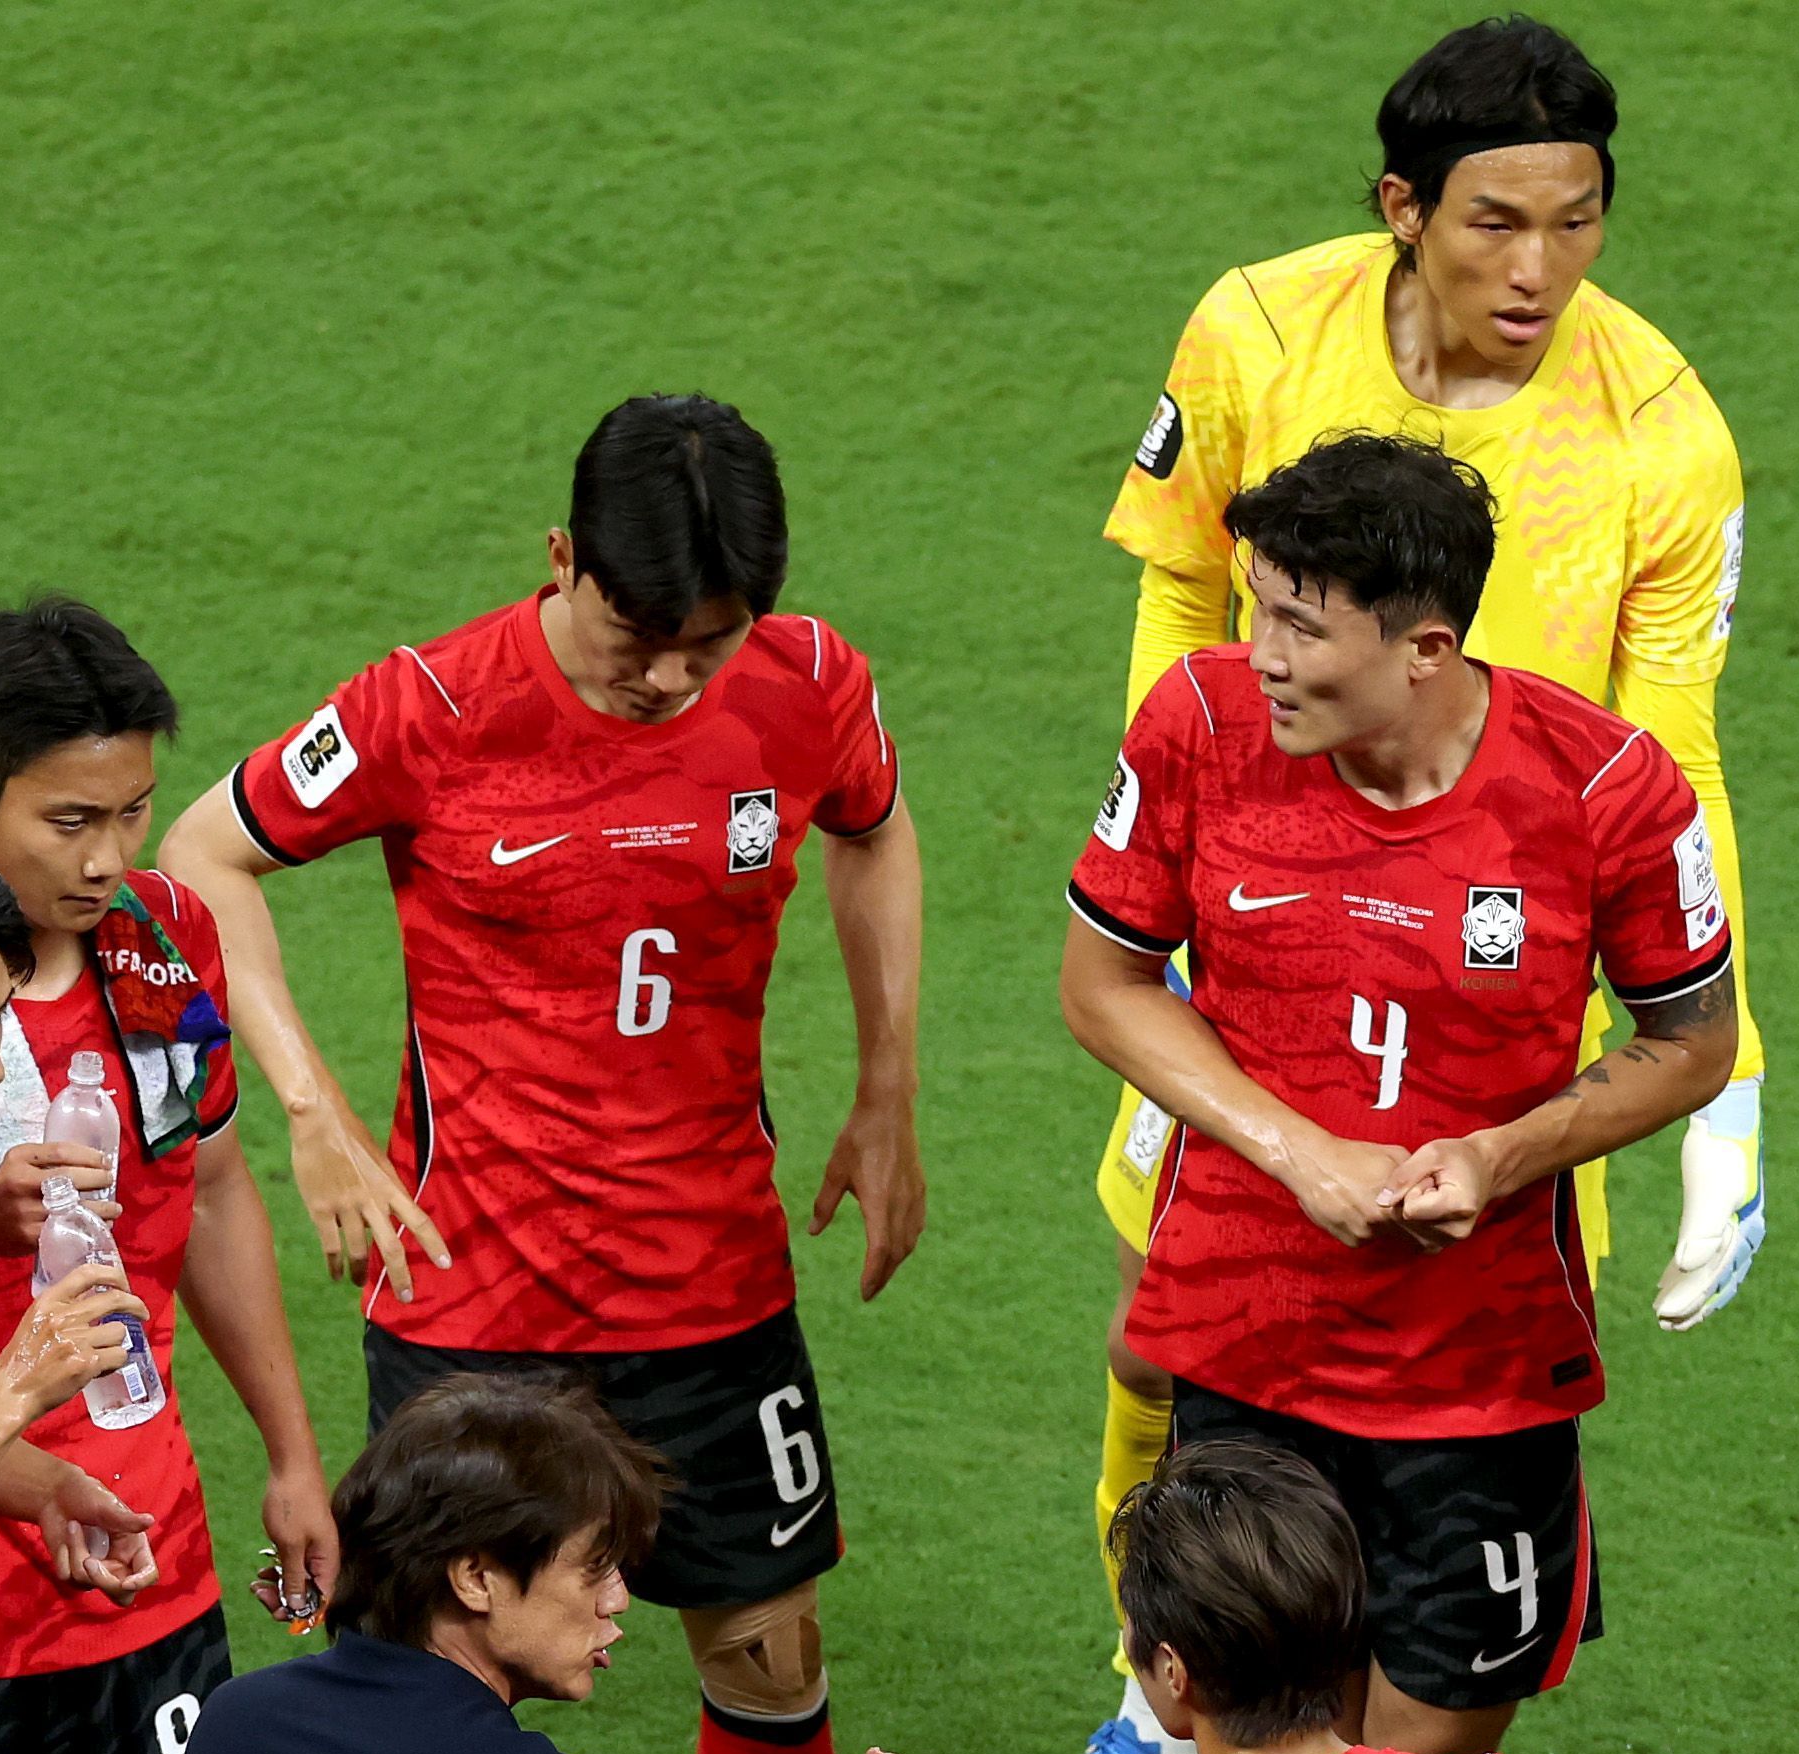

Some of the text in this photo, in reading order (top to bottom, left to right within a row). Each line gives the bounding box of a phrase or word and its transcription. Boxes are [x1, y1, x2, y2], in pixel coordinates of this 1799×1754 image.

[97, 949, 142, 975] IFA
[616, 928, 678, 1037] 6
[1350, 994, 1410, 1110] 4
[757, 1385, 821, 1504] 6
[1481, 1531, 1540, 1638] 4
